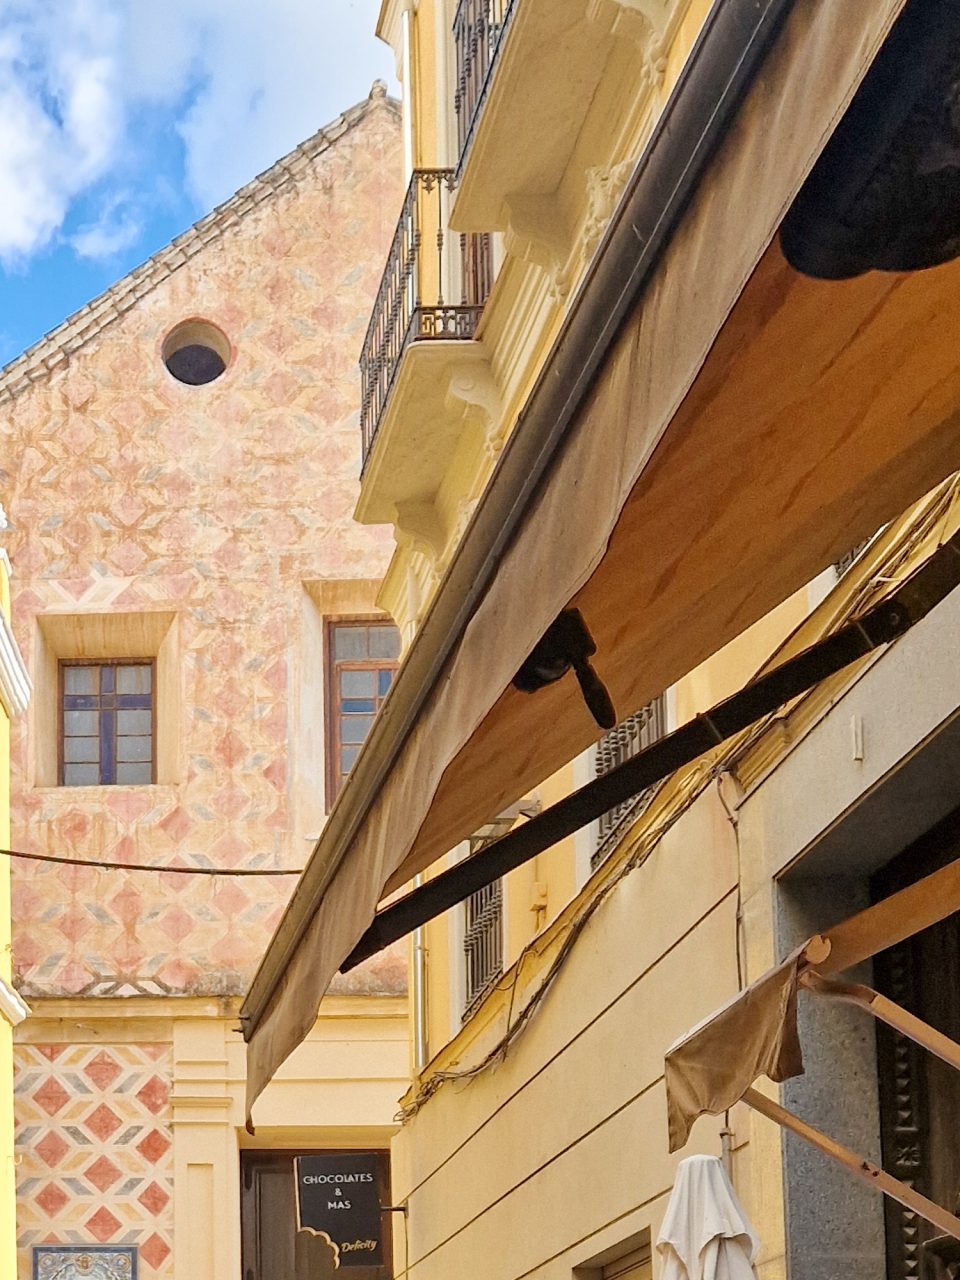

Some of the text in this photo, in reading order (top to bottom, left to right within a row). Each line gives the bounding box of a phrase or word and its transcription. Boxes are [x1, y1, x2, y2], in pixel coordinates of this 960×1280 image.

[303, 1174, 373, 1184] CHOCOLATES
[334, 1187, 343, 1197] &
[327, 1200, 352, 1210] MAS
[341, 1240, 377, 1253] Delicity
